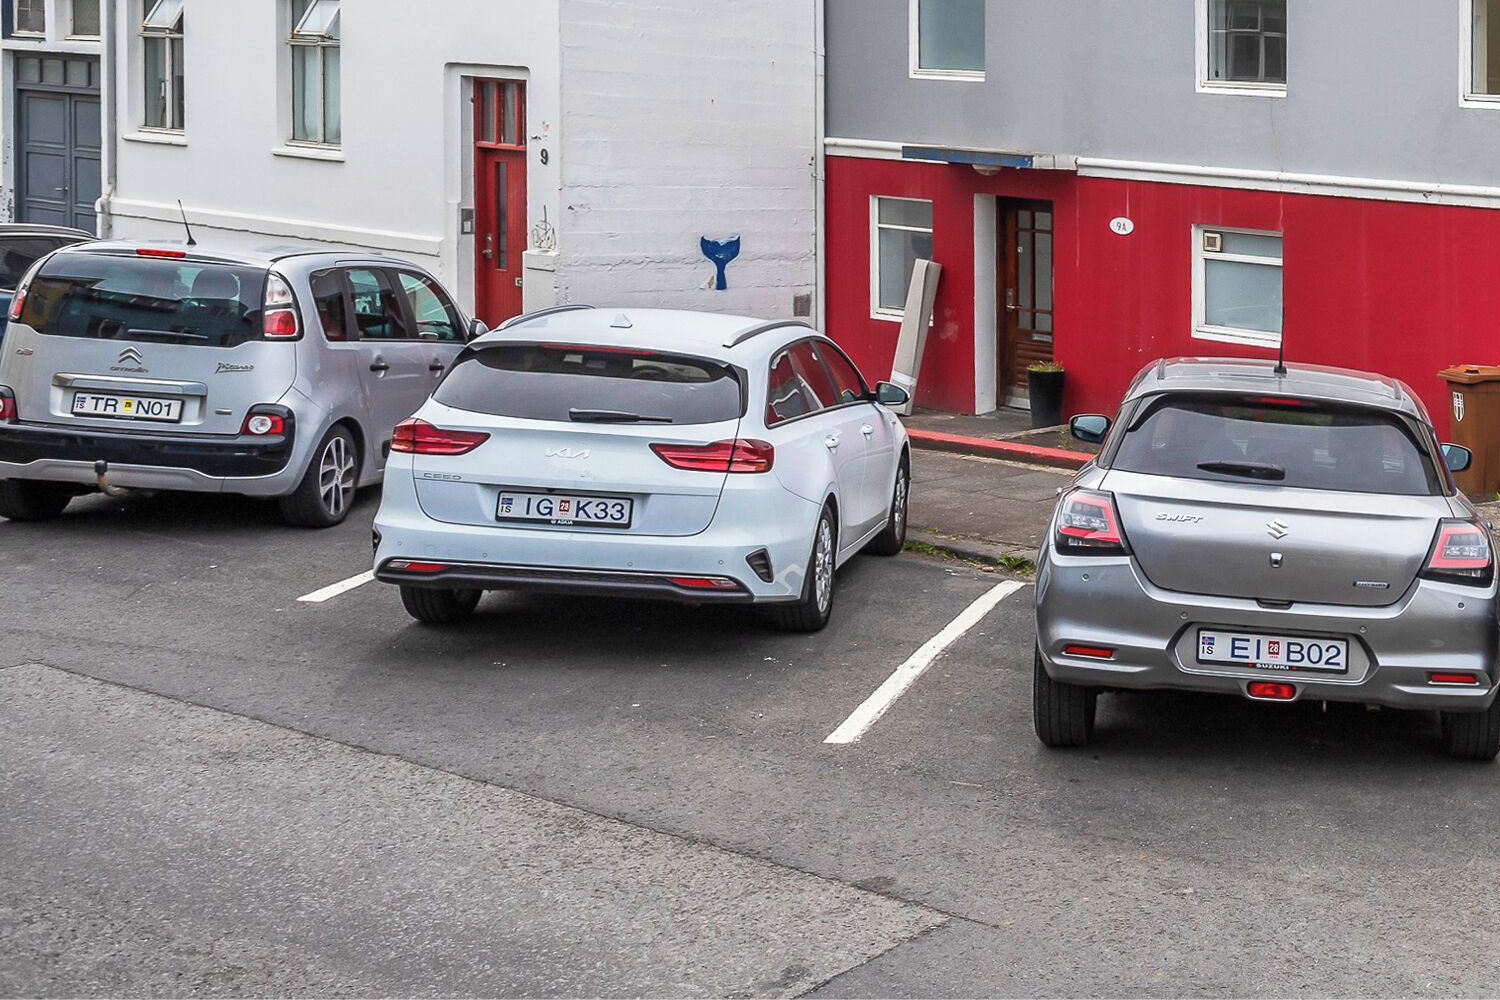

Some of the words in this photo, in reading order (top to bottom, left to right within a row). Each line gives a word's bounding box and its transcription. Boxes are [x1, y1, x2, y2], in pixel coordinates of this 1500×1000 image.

[540, 148, 549, 166] 9
[1116, 221, 1127, 231] 9A
[90, 396, 119, 413] TR
[135, 399, 172, 417] N01
[545, 448, 590, 460] KIA
[500, 505, 512, 514] IS
[525, 497, 554, 517] IG
[575, 500, 625, 521] K33
[1155, 511, 1203, 523] SWIFT
[1201, 646, 1214, 655] IS
[1230, 637, 1261, 660] EI
[1286, 641, 1341, 666] B02
[1269, 643, 1279, 653] 28
[1255, 663, 1290, 671] SUZUKI
